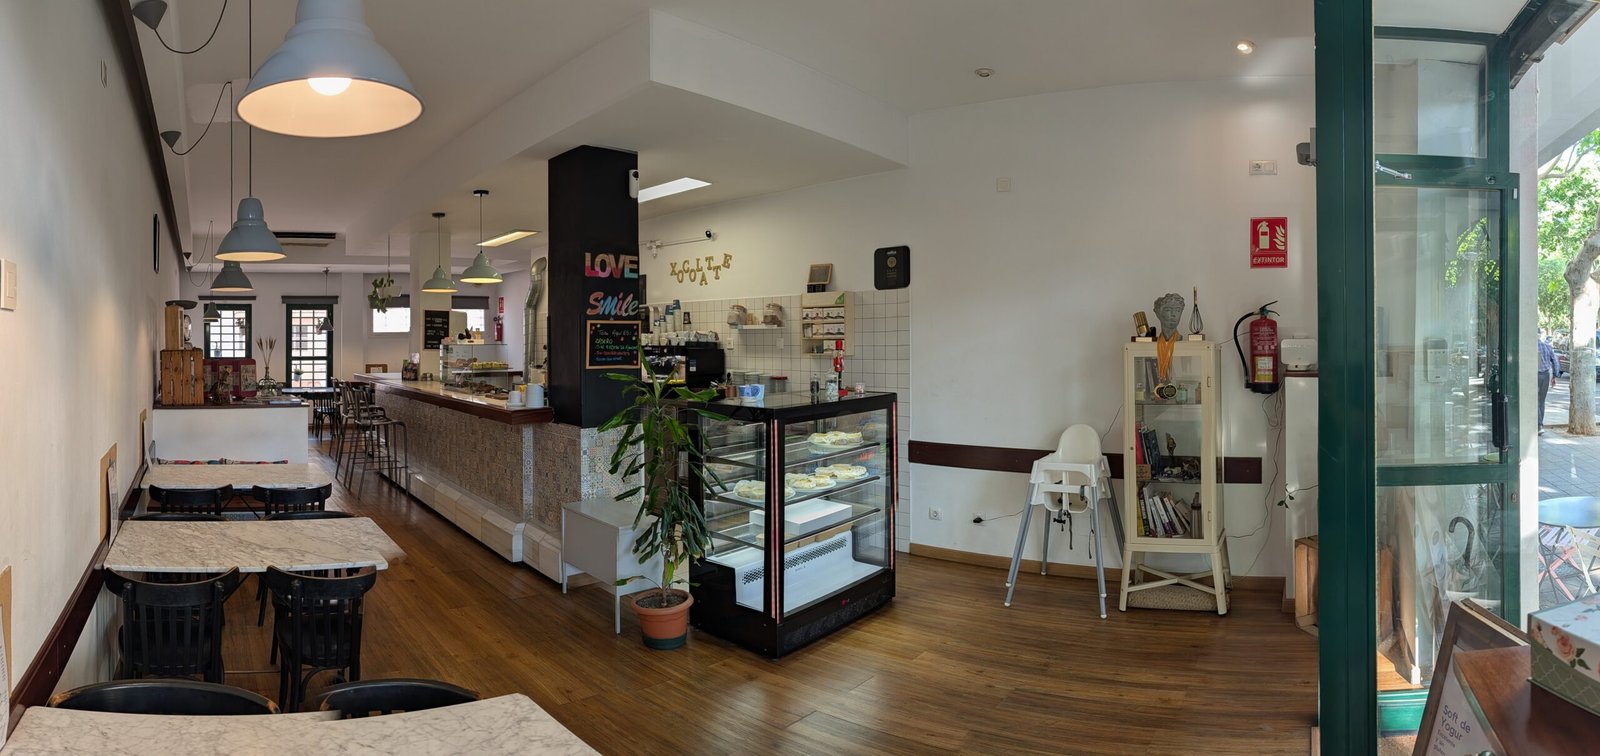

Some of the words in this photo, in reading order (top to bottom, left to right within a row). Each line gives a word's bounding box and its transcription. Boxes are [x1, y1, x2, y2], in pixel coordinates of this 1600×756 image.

[585, 252, 638, 279] LOVE
[586, 291, 639, 317] Smile
[1441, 716, 1463, 741] Yogur
[1443, 704, 1458, 724] Soft
[1460, 720, 1471, 733] de
